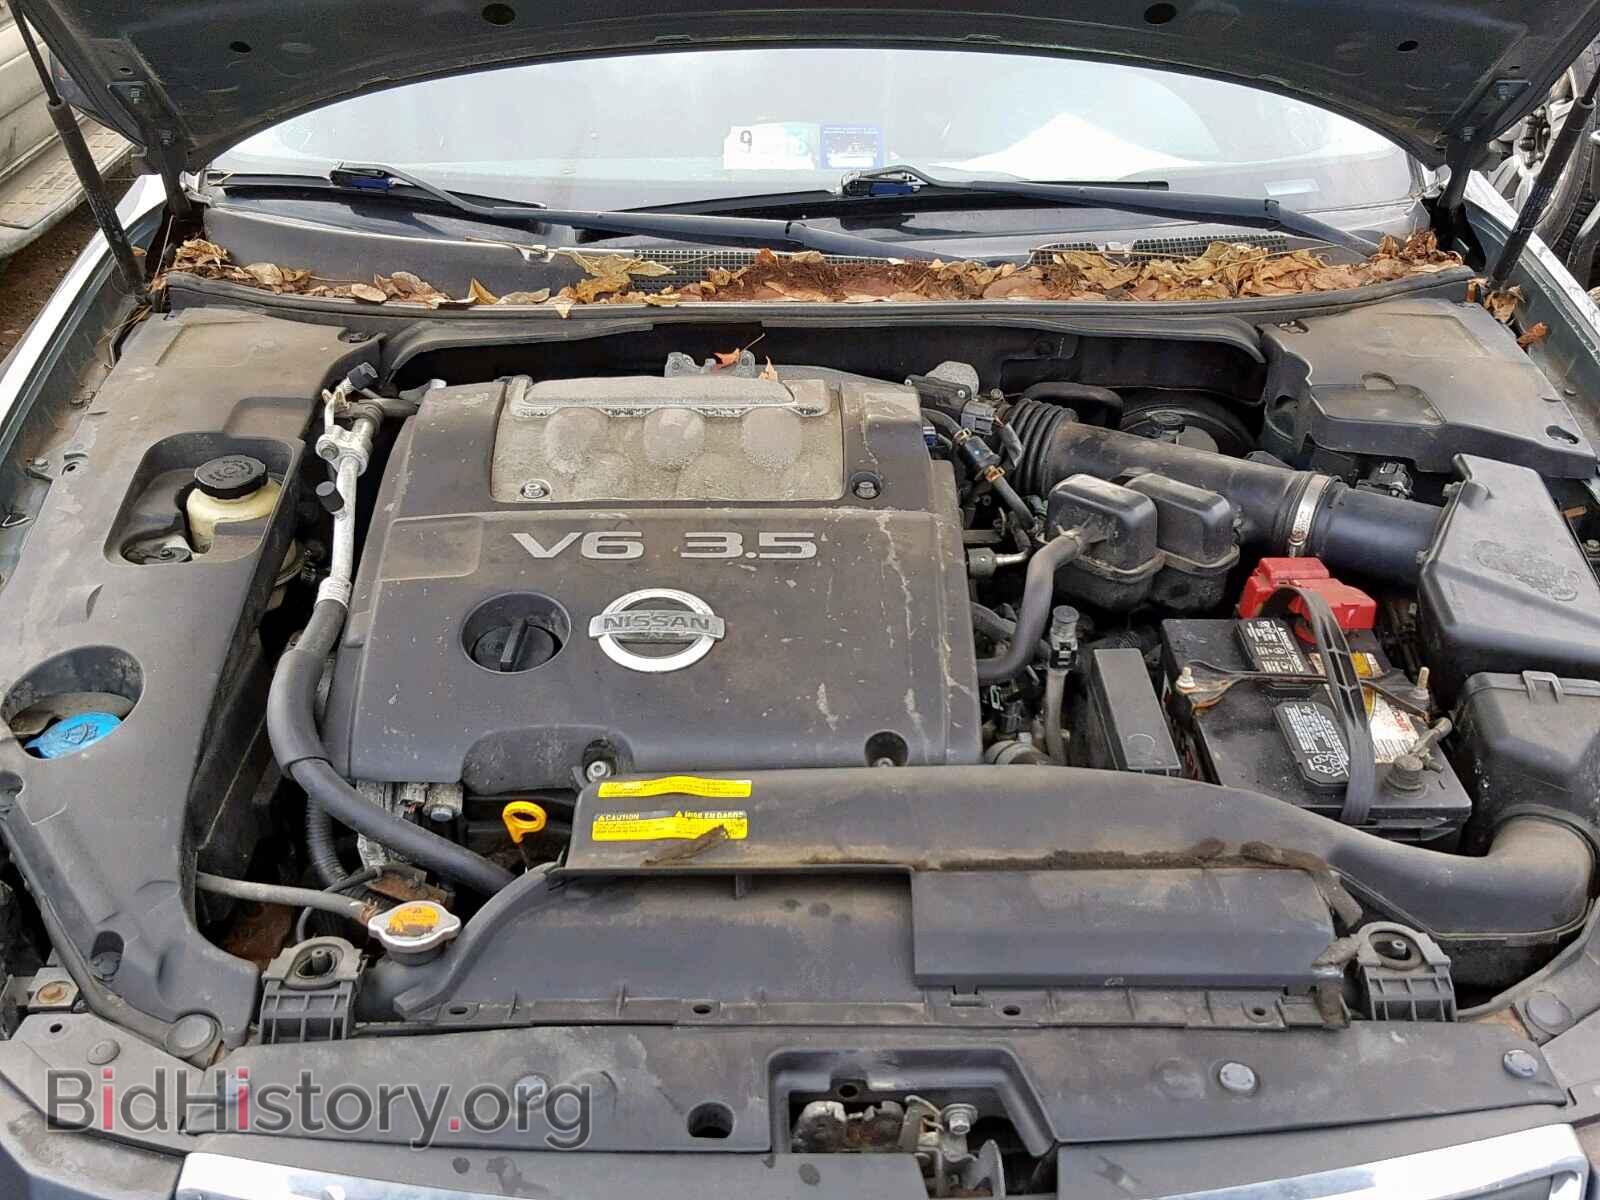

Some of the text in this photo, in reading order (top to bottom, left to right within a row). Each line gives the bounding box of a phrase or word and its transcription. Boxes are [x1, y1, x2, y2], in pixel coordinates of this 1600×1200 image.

[511, 531, 817, 560] V6 3.5
[603, 614, 710, 631] NISSAN
[605, 813, 640, 822] CAUTION
